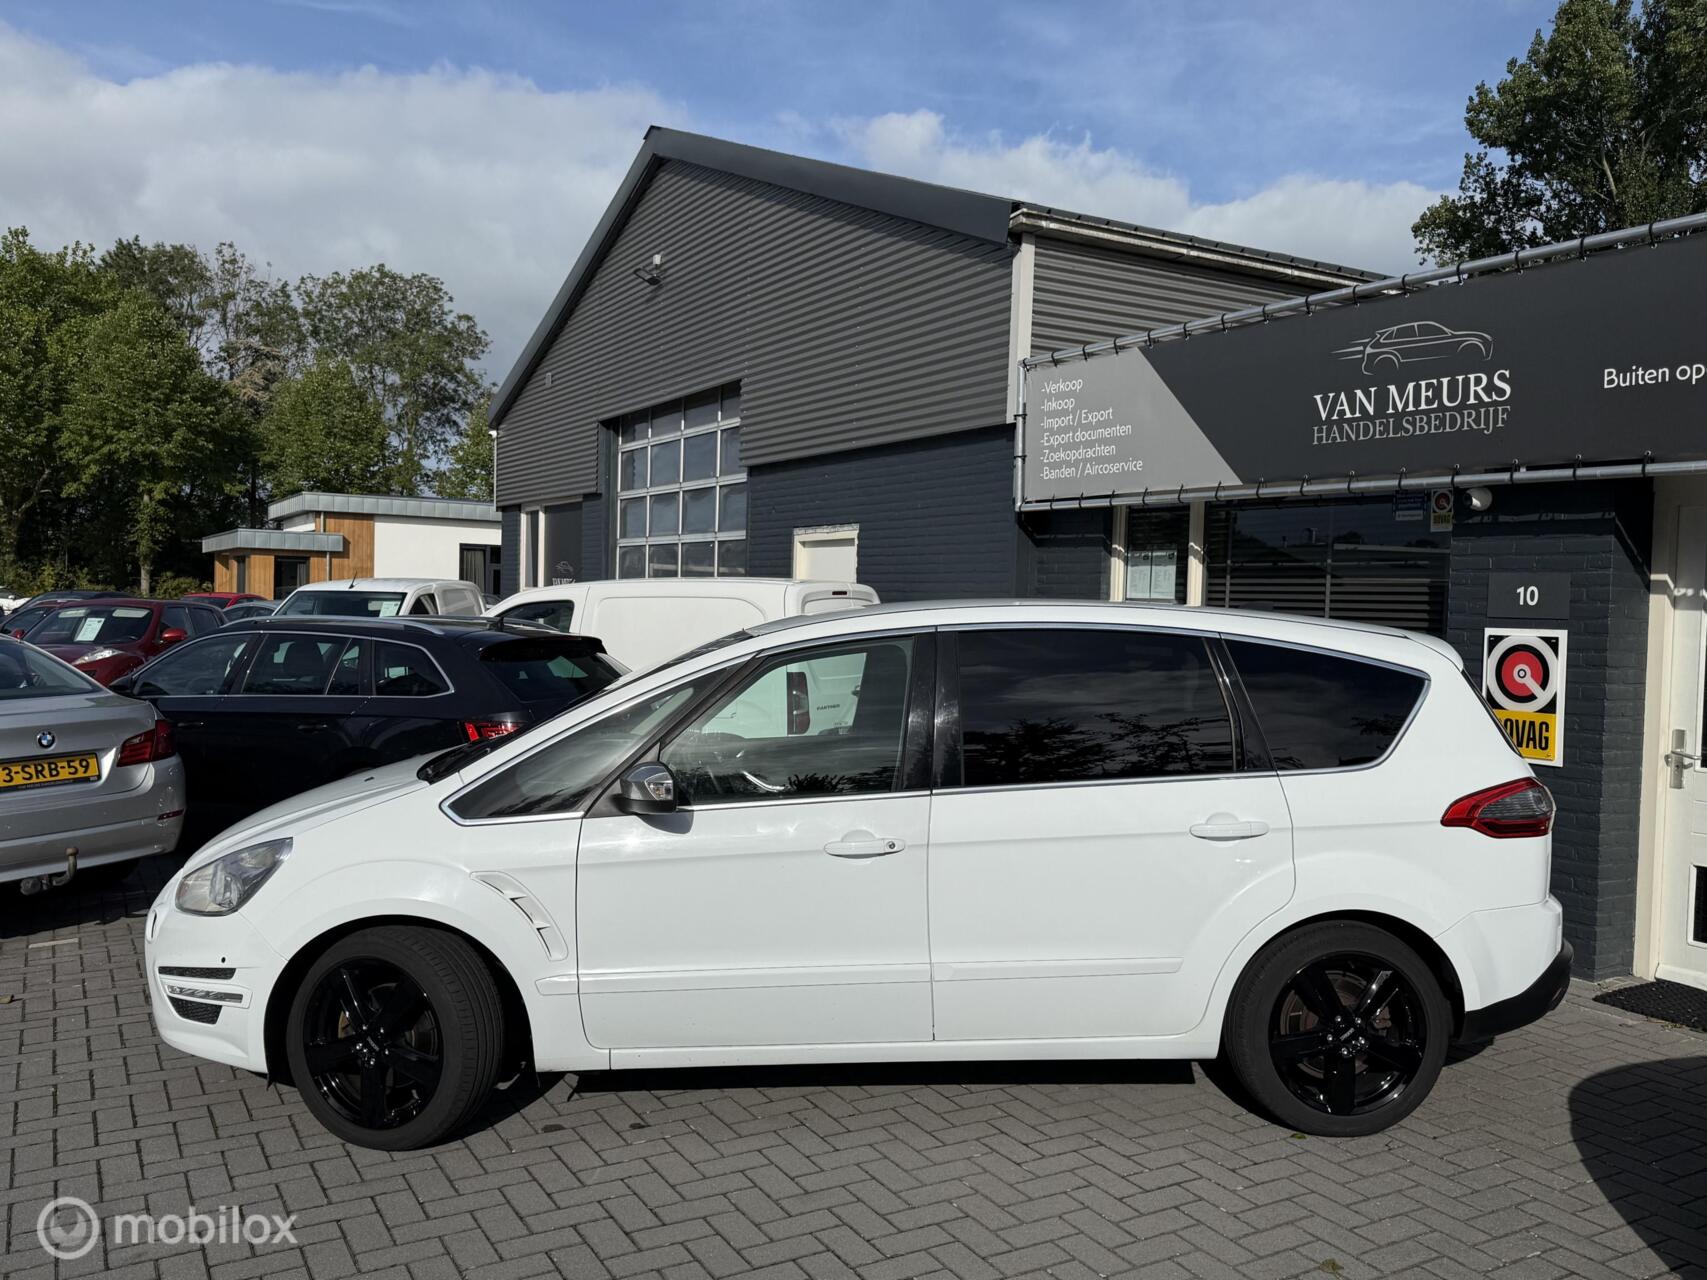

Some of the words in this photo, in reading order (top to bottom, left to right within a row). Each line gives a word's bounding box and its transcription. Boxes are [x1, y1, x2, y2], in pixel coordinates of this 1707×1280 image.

[1041, 379, 1083, 394] -Verkoop
[1603, 365, 1669, 389] Buiten
[1675, 363, 1707, 385] op
[1041, 397, 1075, 412] -Inkoop
[1313, 387, 1378, 422] VAN
[1386, 369, 1512, 414] MEURS
[1041, 413, 1073, 430] -Import
[1081, 407, 1113, 425] Export
[1312, 405, 1511, 445] HANDELSBEDRIJF
[1040, 431, 1073, 448] -Export
[1074, 424, 1132, 442] documenten
[1040, 443, 1116, 463] -Zoekopdrachten
[1040, 464, 1076, 479] -Banden
[1084, 457, 1143, 476] Aircoservice
[1516, 585, 1539, 606] 10
[1500, 718, 1550, 751] OVAG
[2, 758, 90, 783] 3-SRB-59
